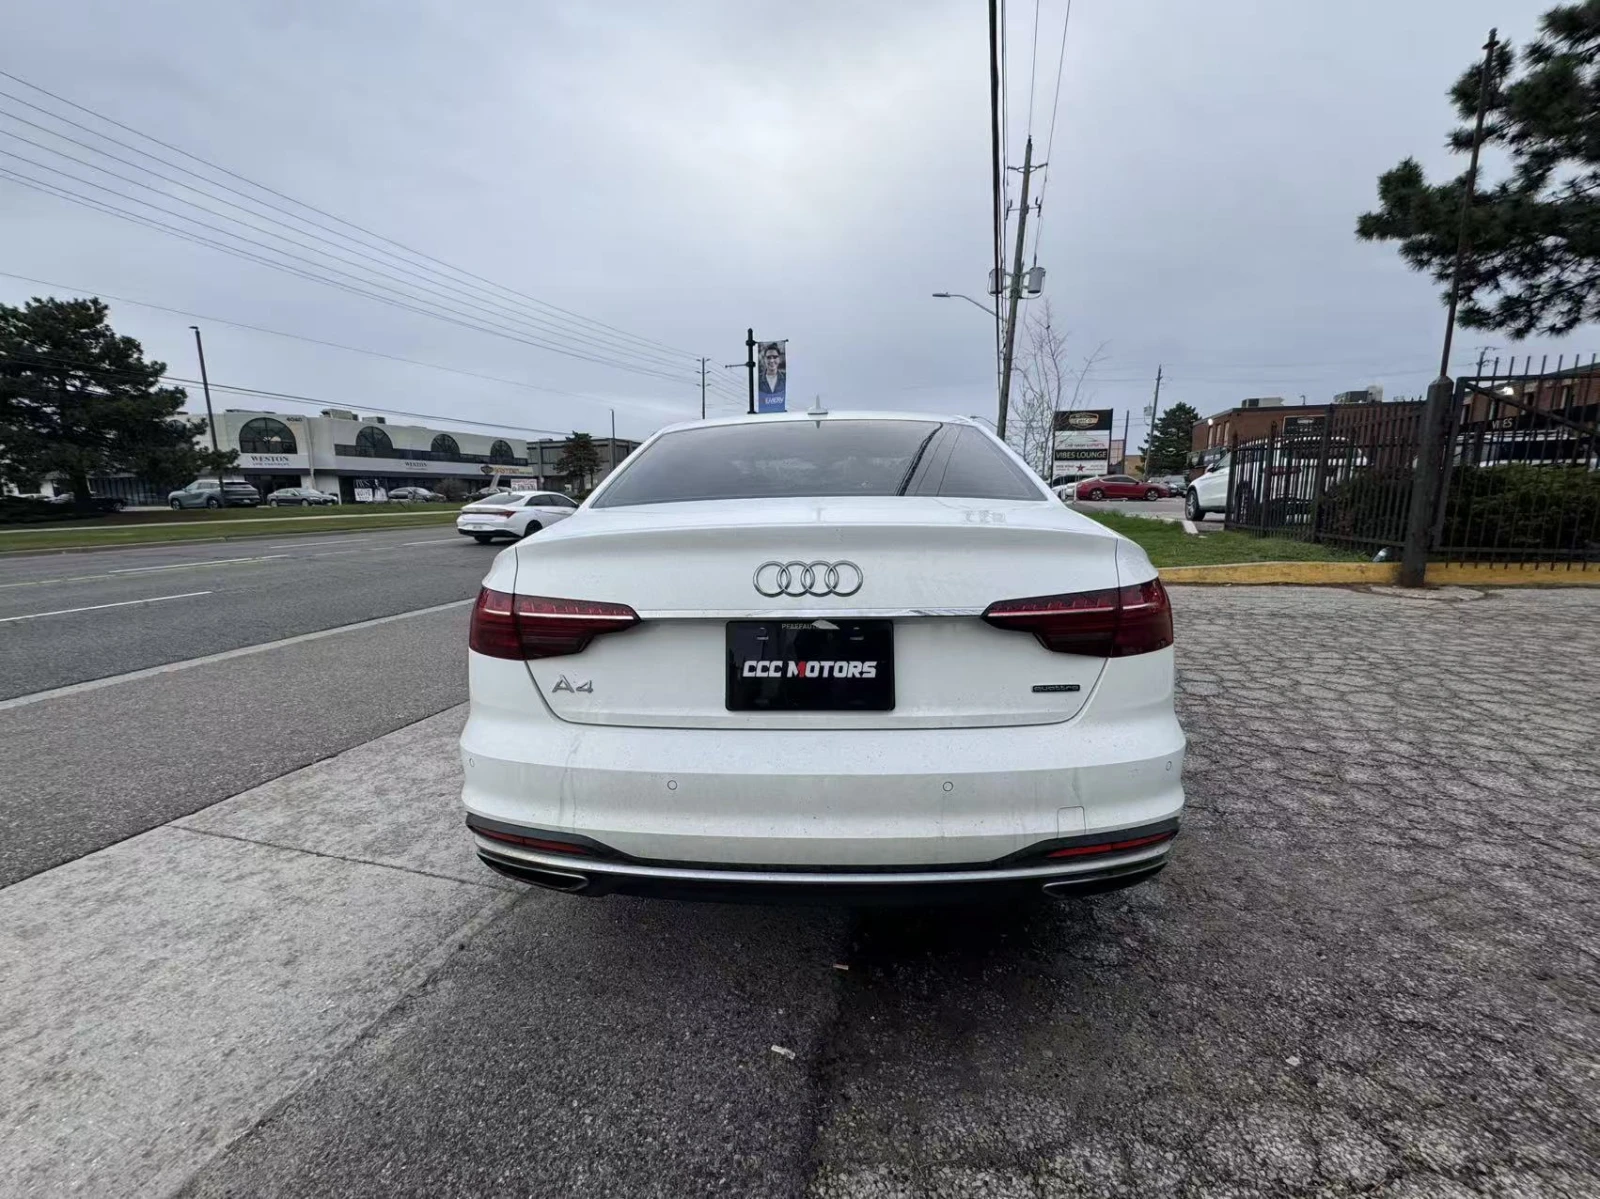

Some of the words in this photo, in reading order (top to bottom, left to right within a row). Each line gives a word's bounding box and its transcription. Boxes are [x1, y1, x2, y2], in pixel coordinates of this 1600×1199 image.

[1492, 418, 1513, 429] VIES
[1056, 451, 1076, 459] VIBES
[1077, 451, 1107, 459] LOUNGE
[742, 660, 783, 678] CCC
[786, 660, 877, 678] MOTORS
[552, 674, 594, 693] A4
